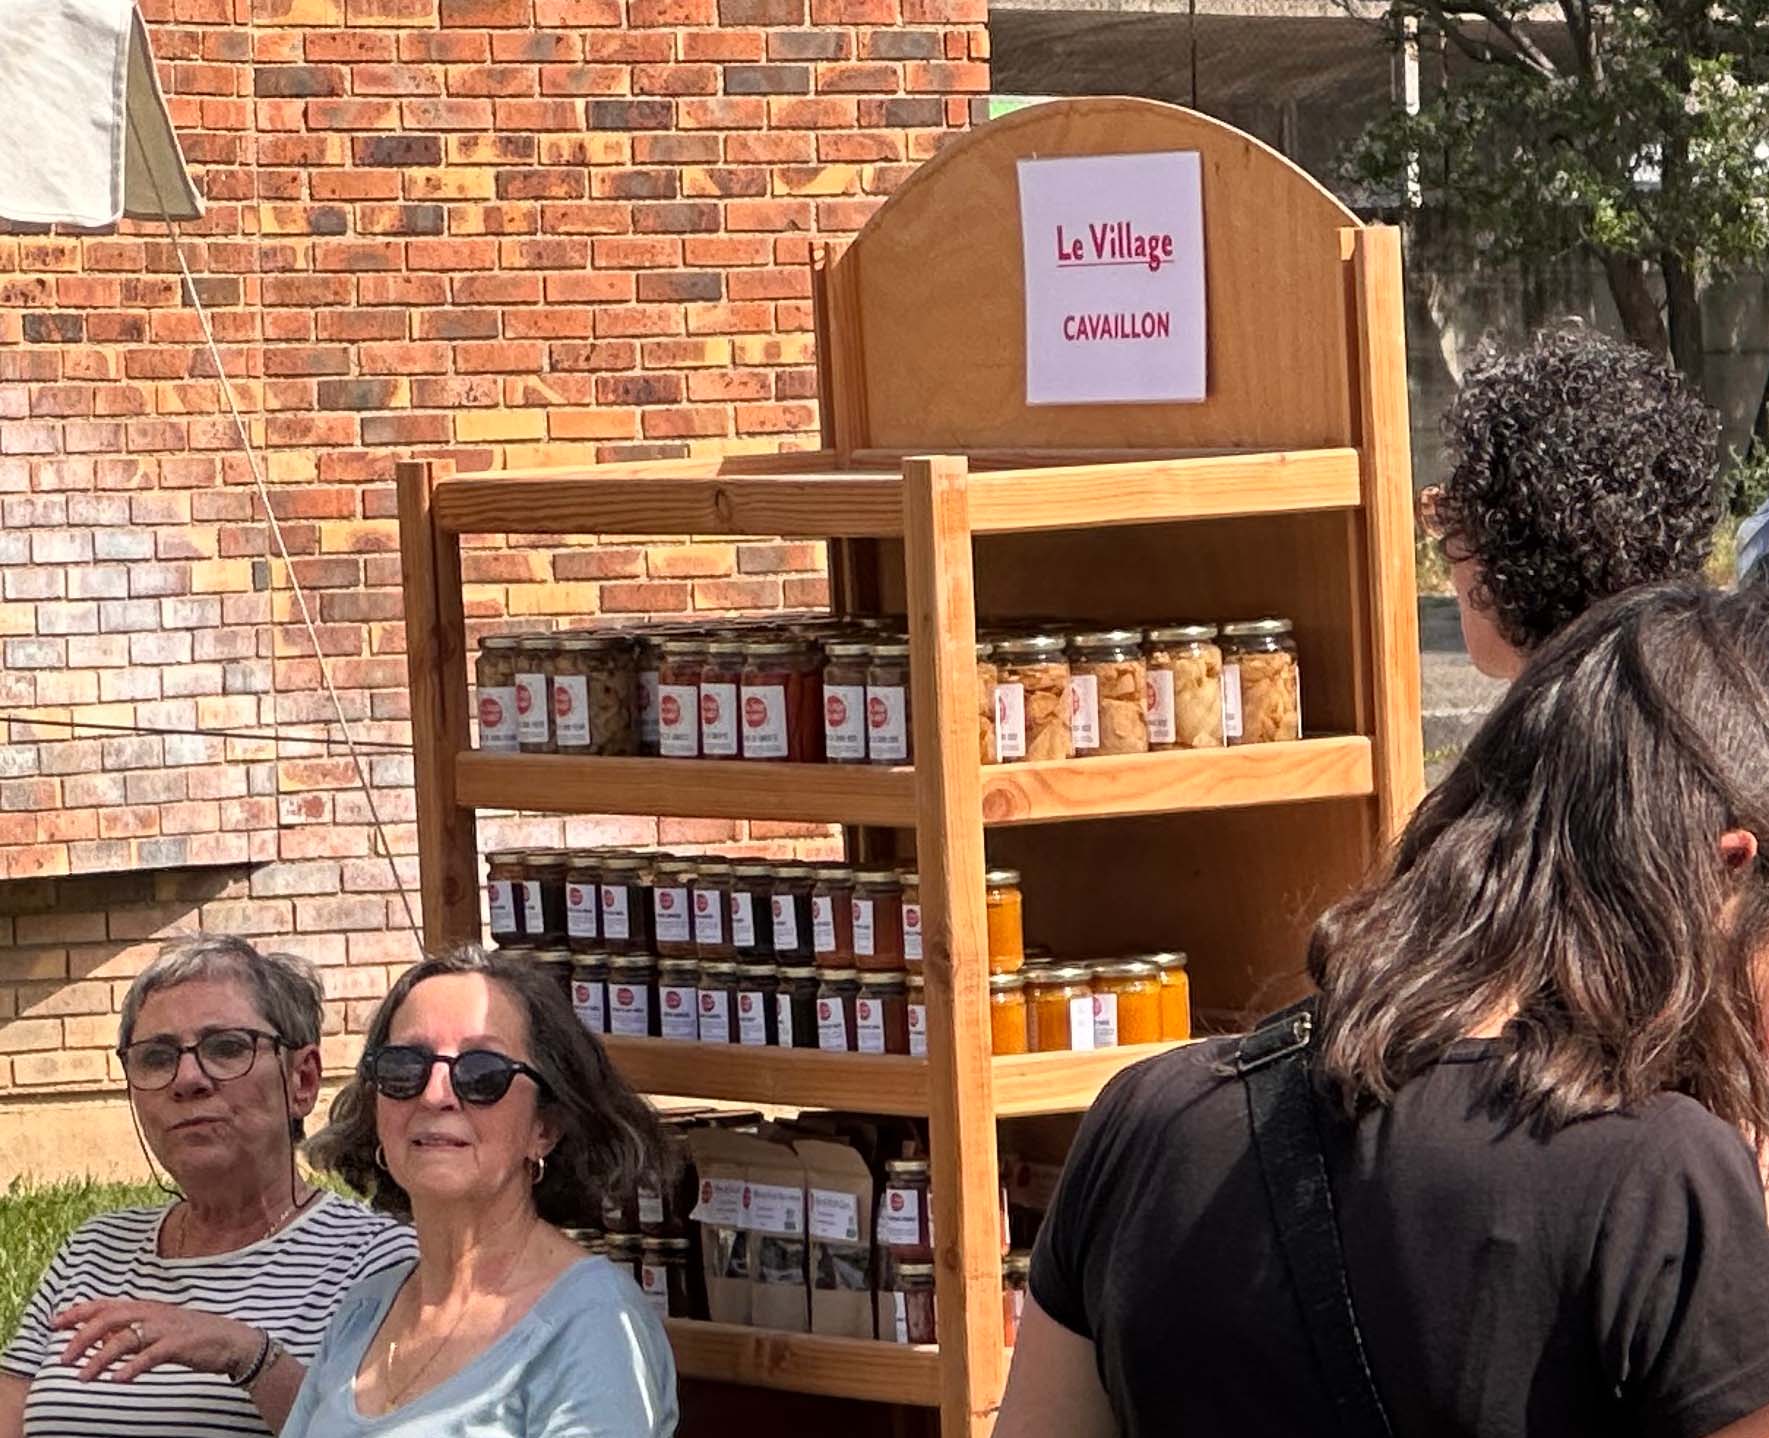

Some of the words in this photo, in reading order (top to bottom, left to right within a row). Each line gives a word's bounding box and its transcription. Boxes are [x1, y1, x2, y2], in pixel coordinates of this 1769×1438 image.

[1056, 225, 1084, 261] Le
[1088, 221, 1174, 272] Village
[1063, 311, 1170, 342] CAVAILLON
